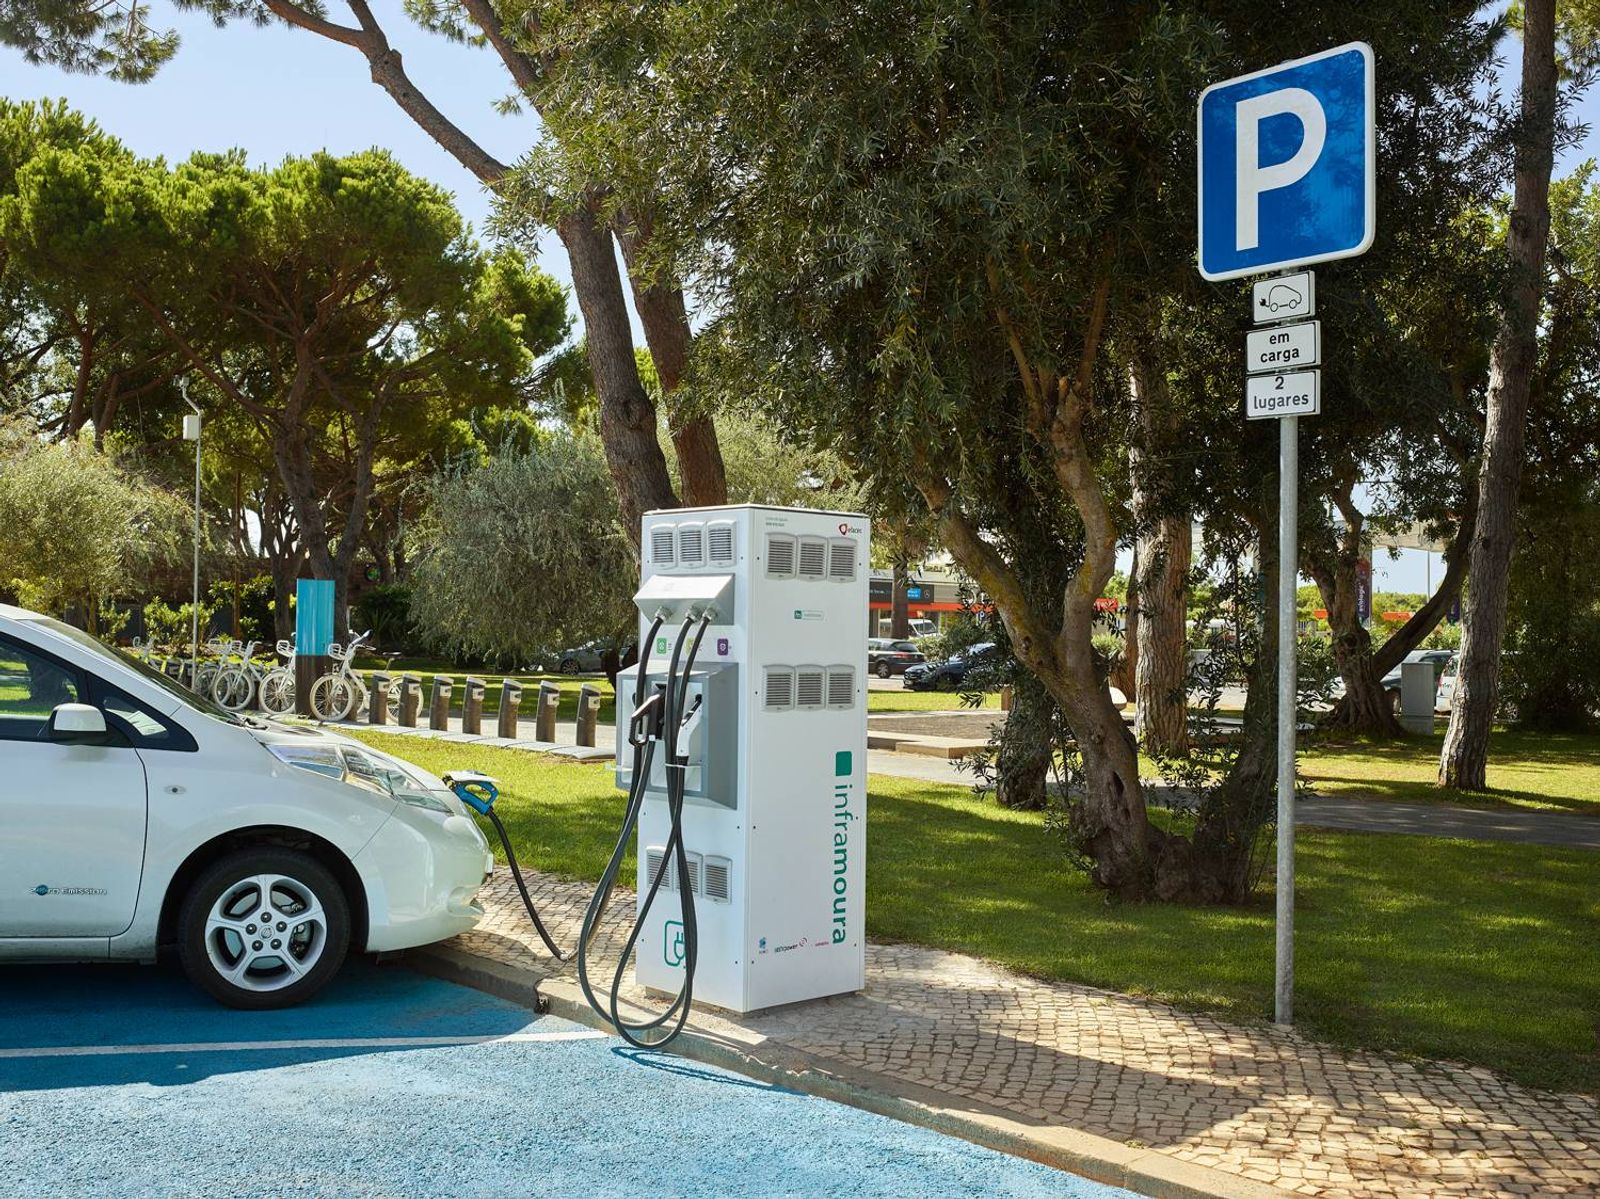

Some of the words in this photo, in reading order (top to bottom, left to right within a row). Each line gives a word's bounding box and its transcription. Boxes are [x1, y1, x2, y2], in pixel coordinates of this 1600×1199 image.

[1236, 87, 1326, 251] P
[1269, 333, 1290, 345] em
[1260, 348, 1300, 362] carga
[1274, 376, 1285, 390] 2
[1253, 394, 1309, 411] lugares
[832, 783, 853, 945] inframoura
